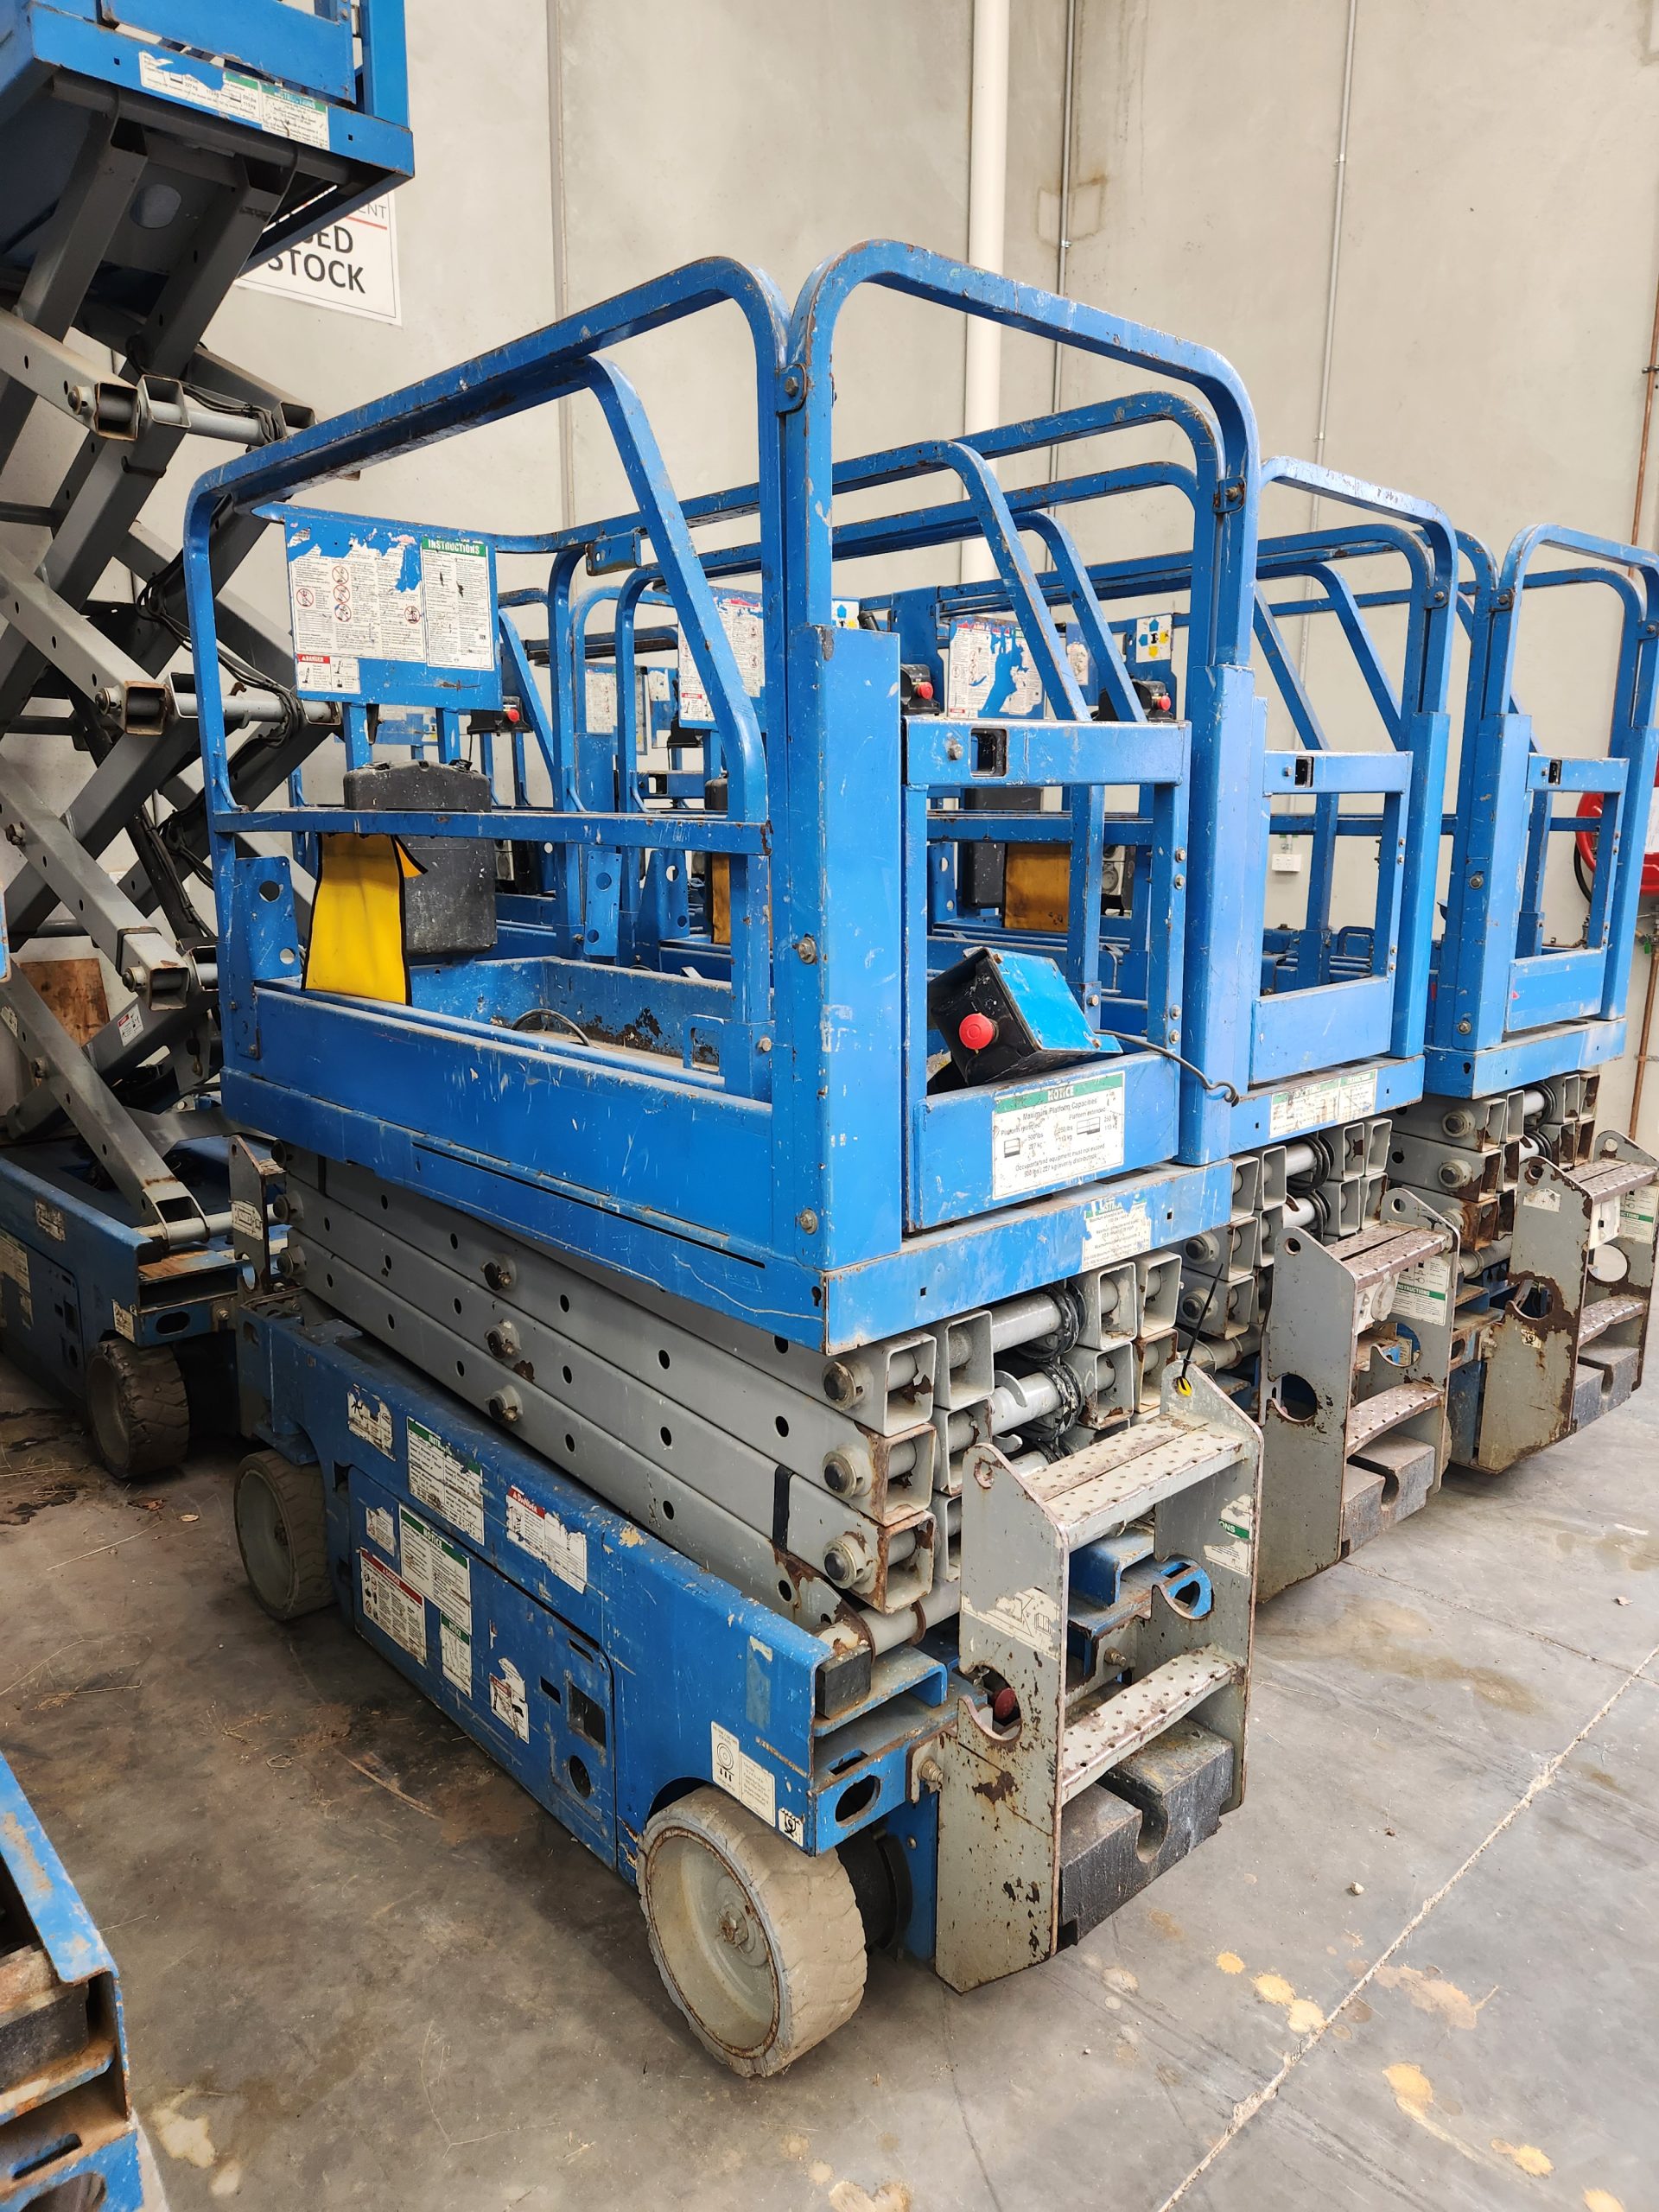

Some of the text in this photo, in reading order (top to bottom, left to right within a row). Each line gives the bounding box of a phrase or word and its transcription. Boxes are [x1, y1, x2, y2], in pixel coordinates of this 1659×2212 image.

[268, 248, 365, 294] STOCK
[428, 538, 480, 555] INSTRUCTIONS
[1048, 1085, 1074, 1102] NOTICE
[1023, 1098, 1097, 1122] Maximum Platform Capacities
[1069, 1110, 1086, 1121] Platform
[423, 1528, 442, 1549] NOTICE
